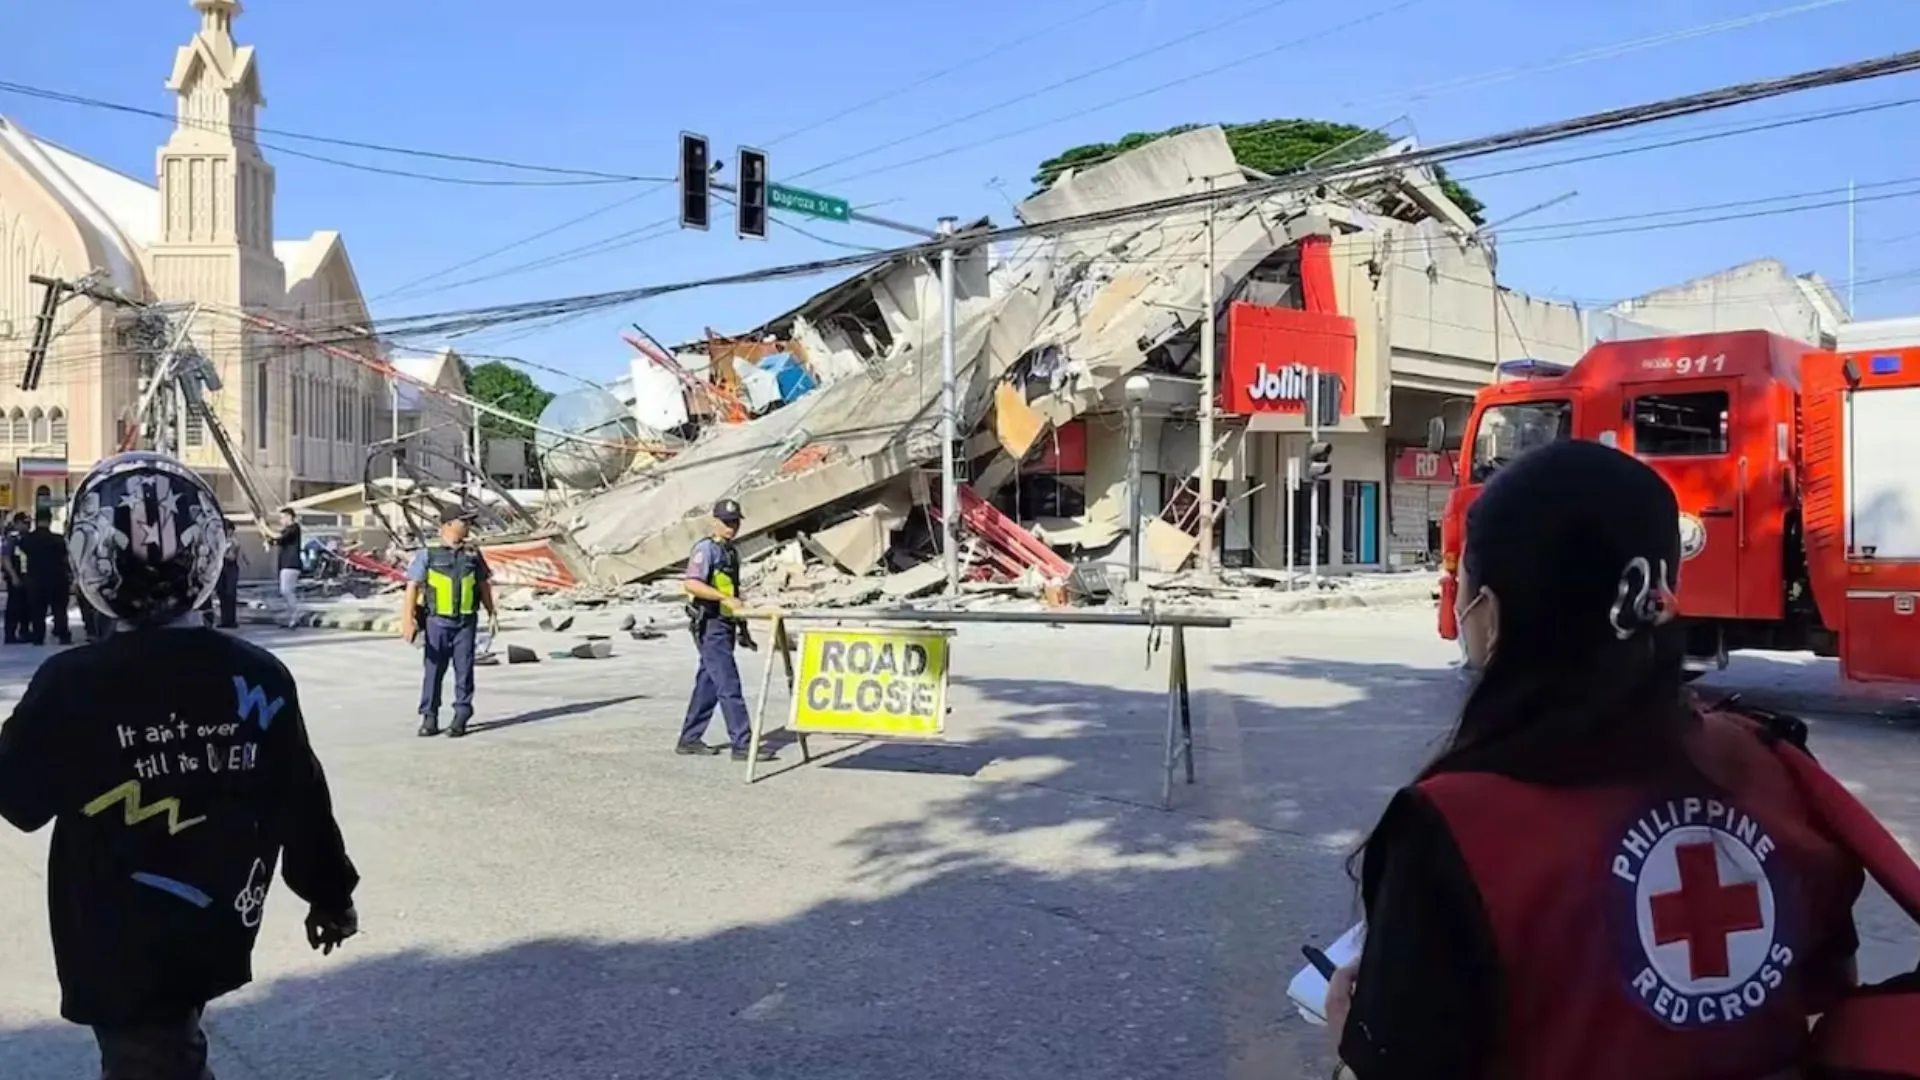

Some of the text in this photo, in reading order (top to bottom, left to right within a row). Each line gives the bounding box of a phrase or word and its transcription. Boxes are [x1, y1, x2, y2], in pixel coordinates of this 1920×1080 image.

[1246, 362, 1344, 400] Jolli
[1675, 354, 1726, 374] 911
[820, 640, 928, 676] ROAD
[807, 677, 935, 716] CLOSE
[116, 711, 239, 748] It ain't over
[134, 751, 170, 779] till
[206, 742, 258, 774] OER!
[1612, 797, 1776, 883] PHILIPPINE
[1632, 943, 1794, 1025] RED CROSS
